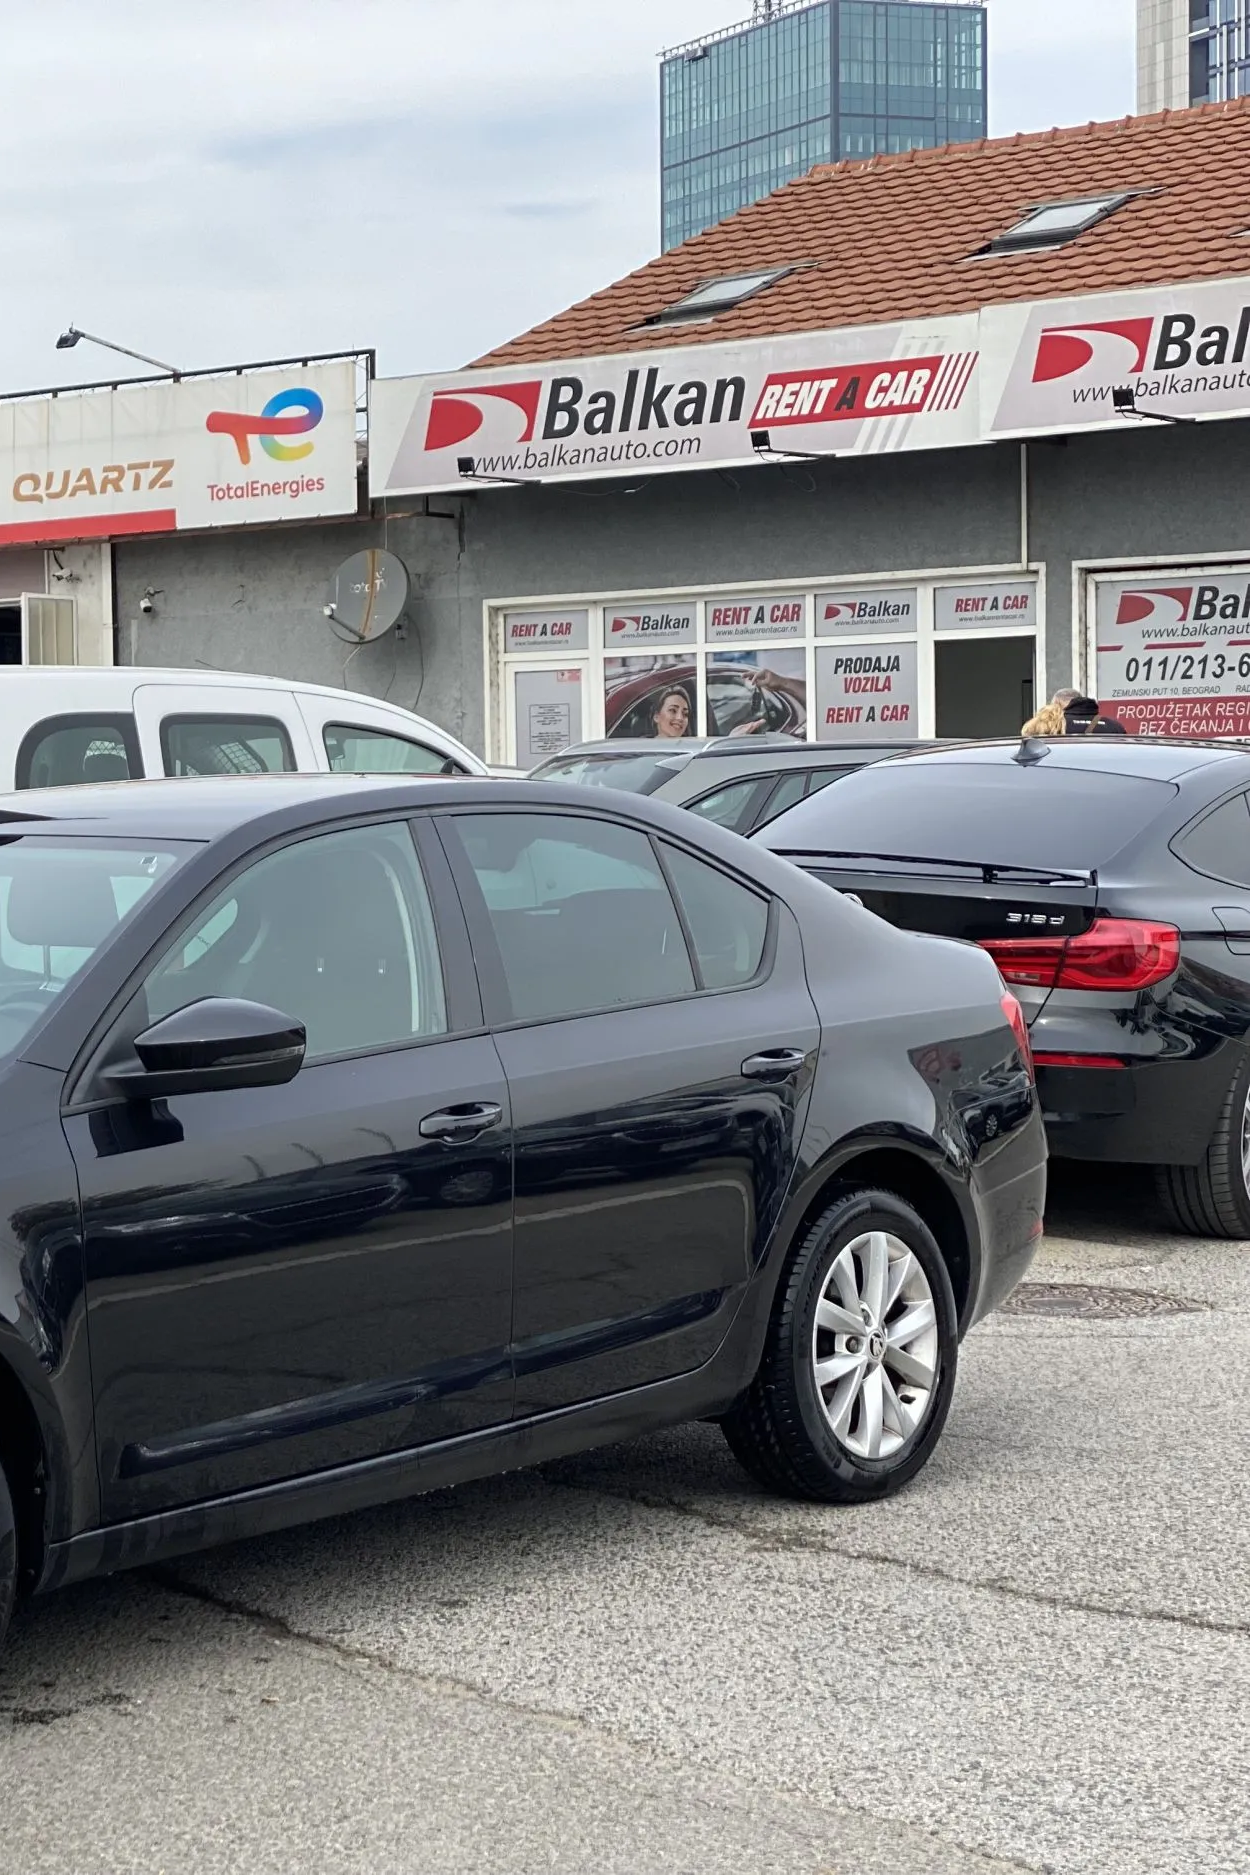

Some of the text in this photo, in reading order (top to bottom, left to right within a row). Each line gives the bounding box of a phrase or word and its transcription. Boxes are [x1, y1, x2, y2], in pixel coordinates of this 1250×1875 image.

[542, 366, 747, 440] Balkan
[755, 367, 932, 421] RENT A CAR
[12, 458, 176, 505] QUARTZ
[207, 474, 326, 502] TotalEnergies
[856, 600, 910, 618] Balkan
[954, 594, 1029, 613] RENT A CAR
[640, 613, 690, 632] Balkan
[711, 602, 802, 627] RENT A CAR
[510, 621, 573, 638] RENT A CAR
[833, 655, 901, 675] PRODAJA
[843, 675, 892, 694] VOZILA
[1152, 687, 1169, 696] PUT
[1182, 685, 1221, 696] BEOGRAD
[825, 704, 910, 724] RENT A CAR
[1116, 702, 1211, 719] PRODUŽETAK
[1138, 720, 1166, 736] BEZ
[1169, 717, 1235, 734] ČEKANJA
